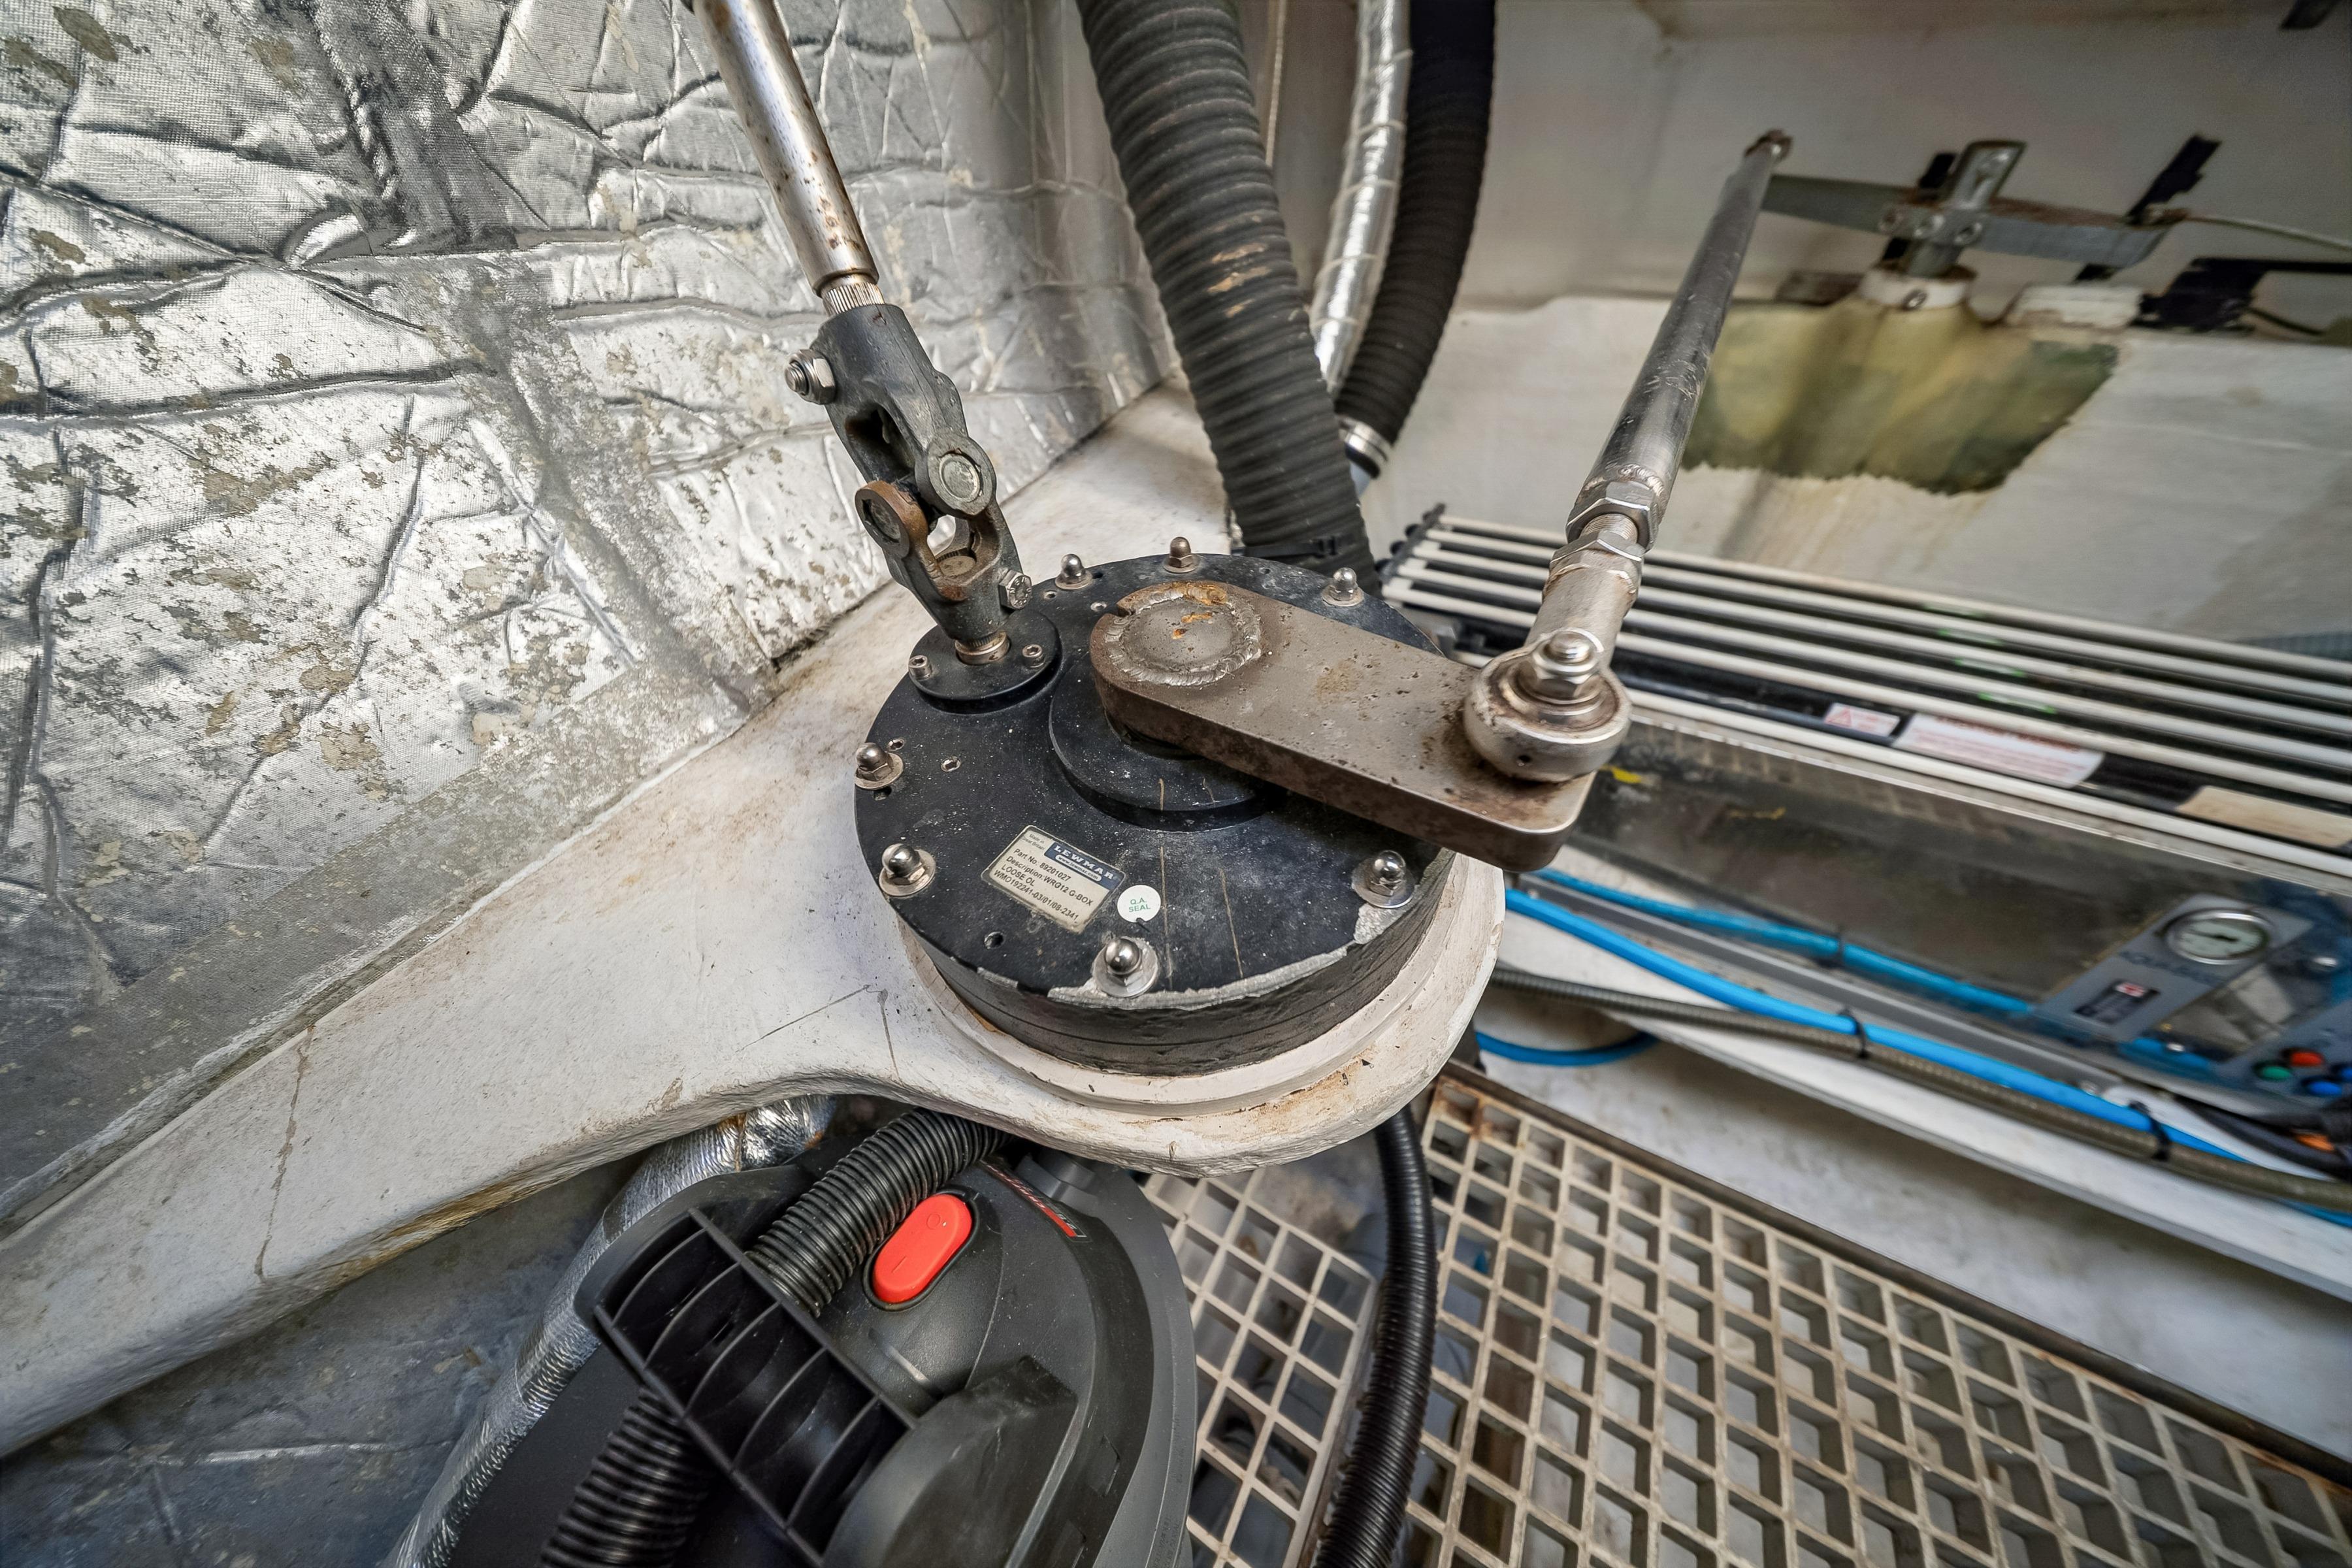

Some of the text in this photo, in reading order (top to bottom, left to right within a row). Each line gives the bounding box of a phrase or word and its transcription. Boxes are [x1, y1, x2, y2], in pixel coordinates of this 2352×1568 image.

[1001, 864, 1035, 886] LOOSE OL
[1014, 848, 1028, 860] Part
[1039, 862, 1071, 881] 89201027
[1053, 845, 1113, 879] LEWMAR
[1128, 904, 1151, 913] SEAL
